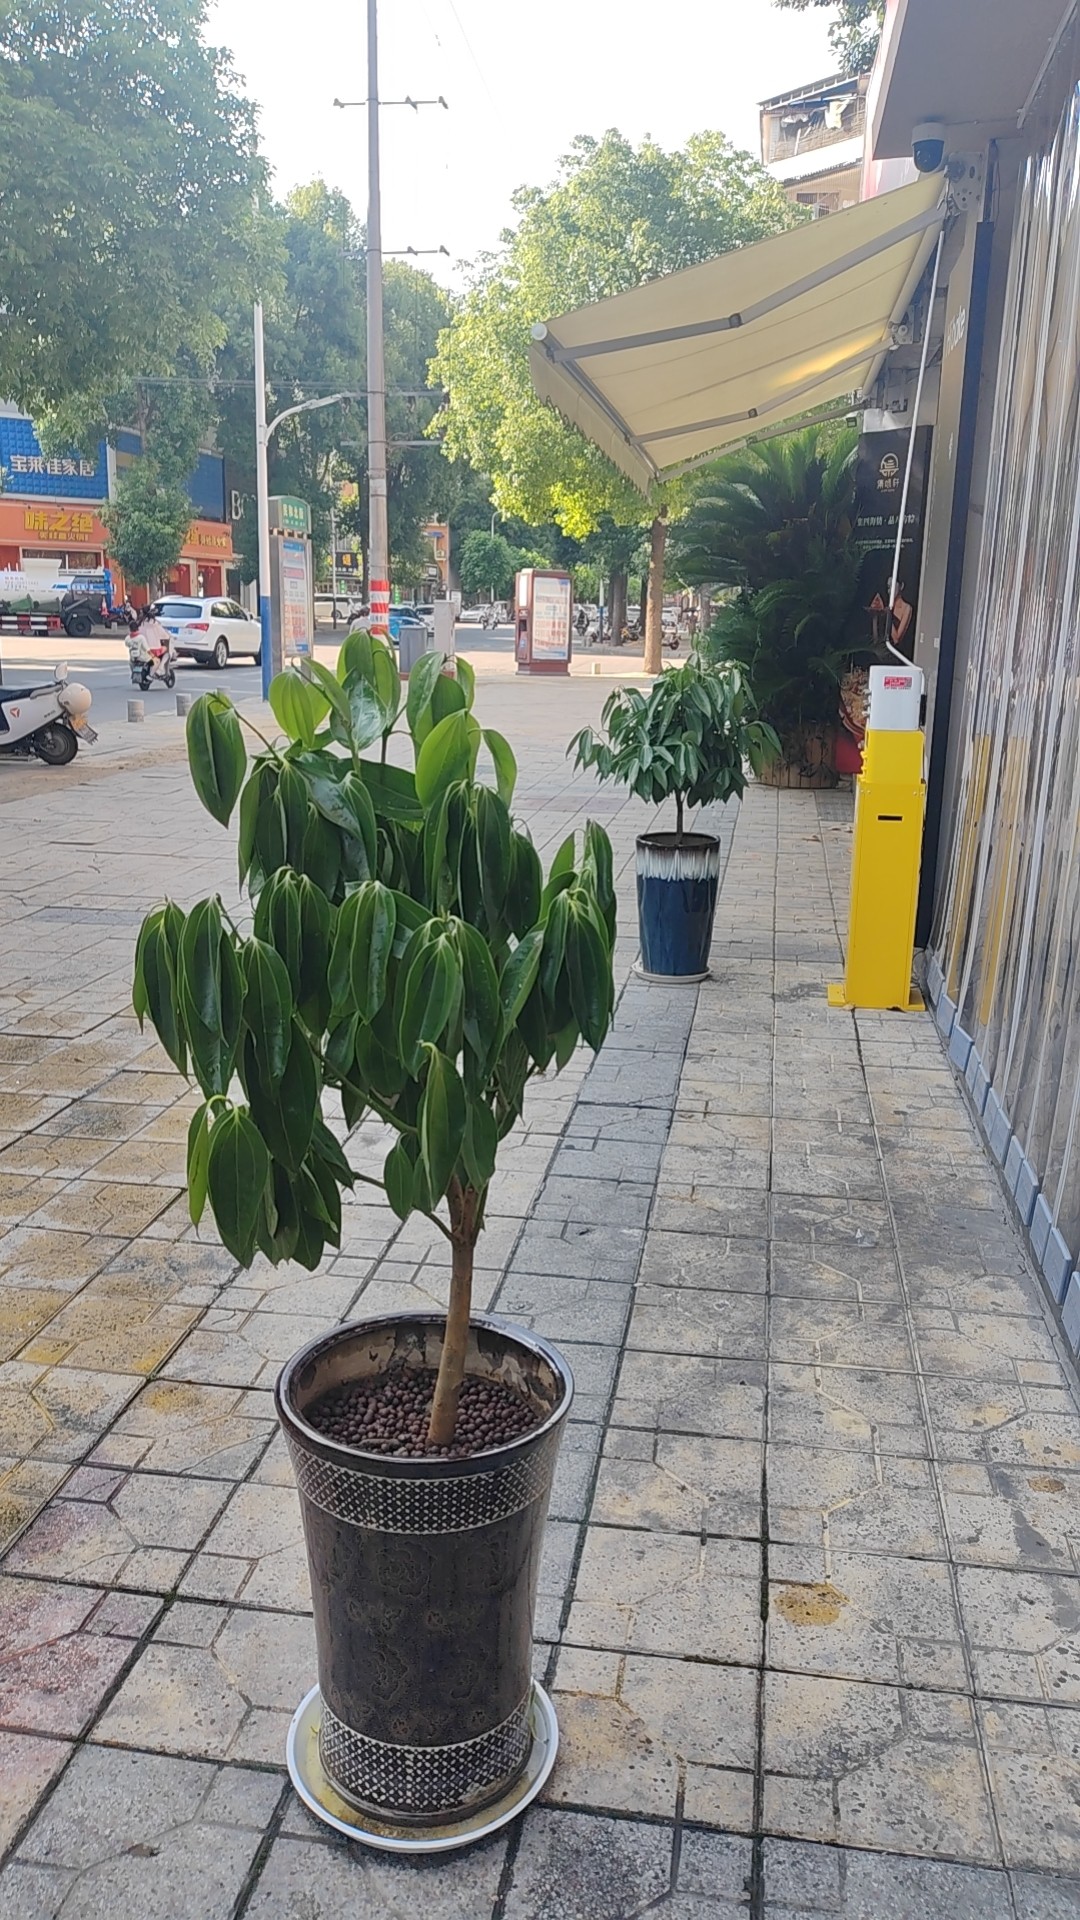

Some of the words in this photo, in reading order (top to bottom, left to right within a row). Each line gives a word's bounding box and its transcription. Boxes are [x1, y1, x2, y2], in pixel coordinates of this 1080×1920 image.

[10, 454, 95, 477] 宝莱佳家居
[24, 510, 94, 534] 味之绝
